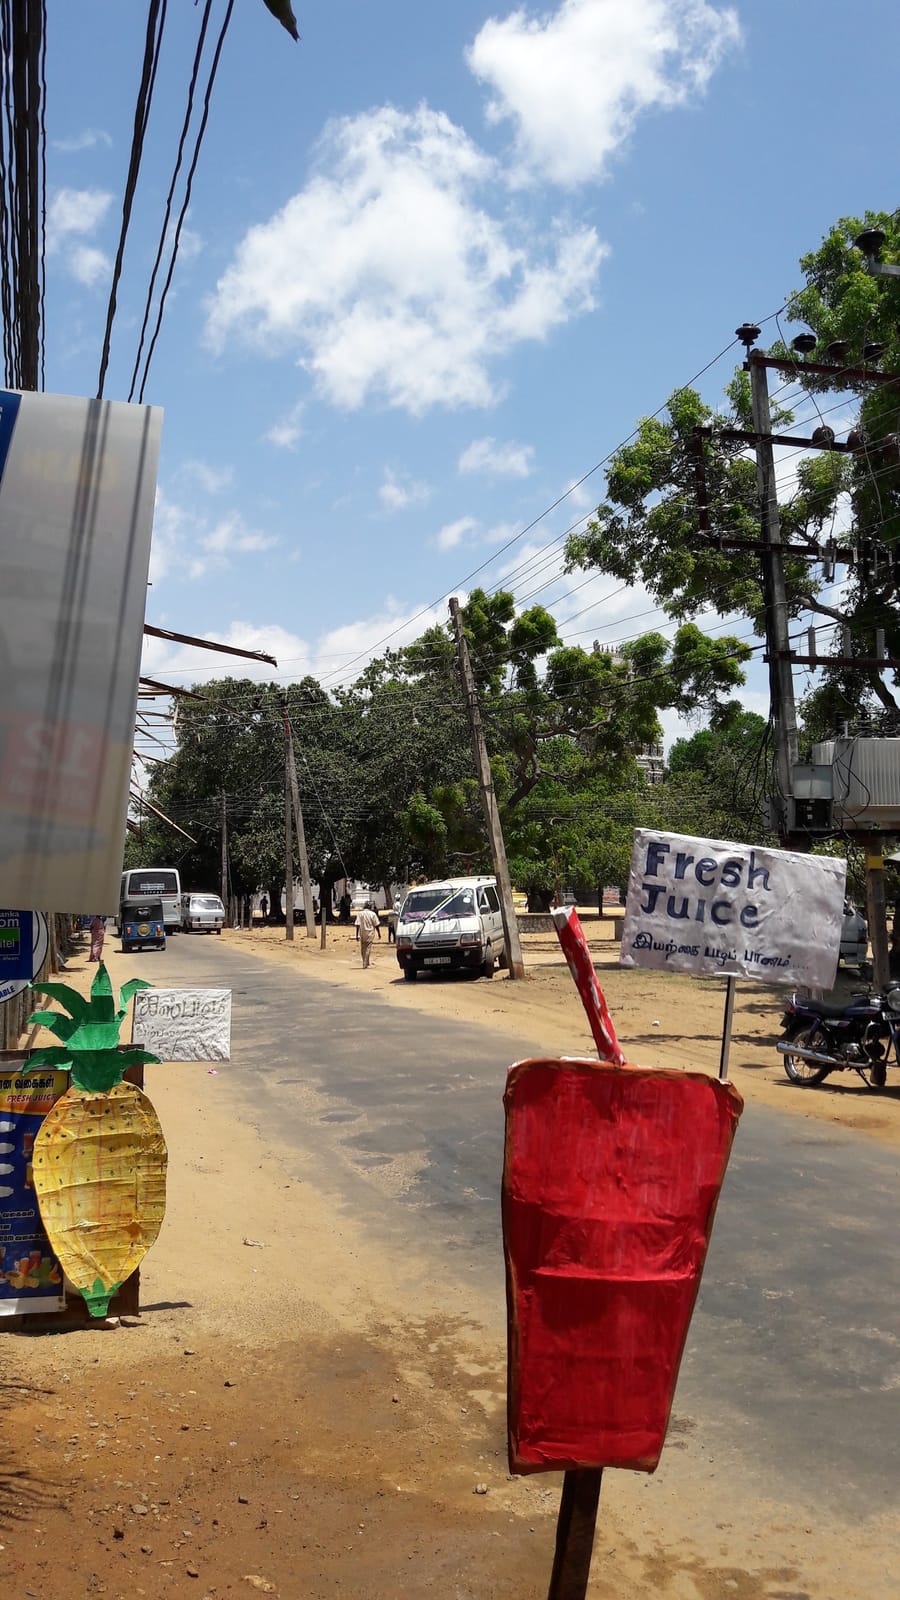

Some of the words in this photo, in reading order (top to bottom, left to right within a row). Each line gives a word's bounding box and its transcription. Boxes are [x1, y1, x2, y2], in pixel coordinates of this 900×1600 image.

[644, 842, 771, 891] Fresh
[640, 883, 760, 928] Juice
[632, 932, 701, 960] இயற்கை
[7, 1094, 32, 1104] FRESH
